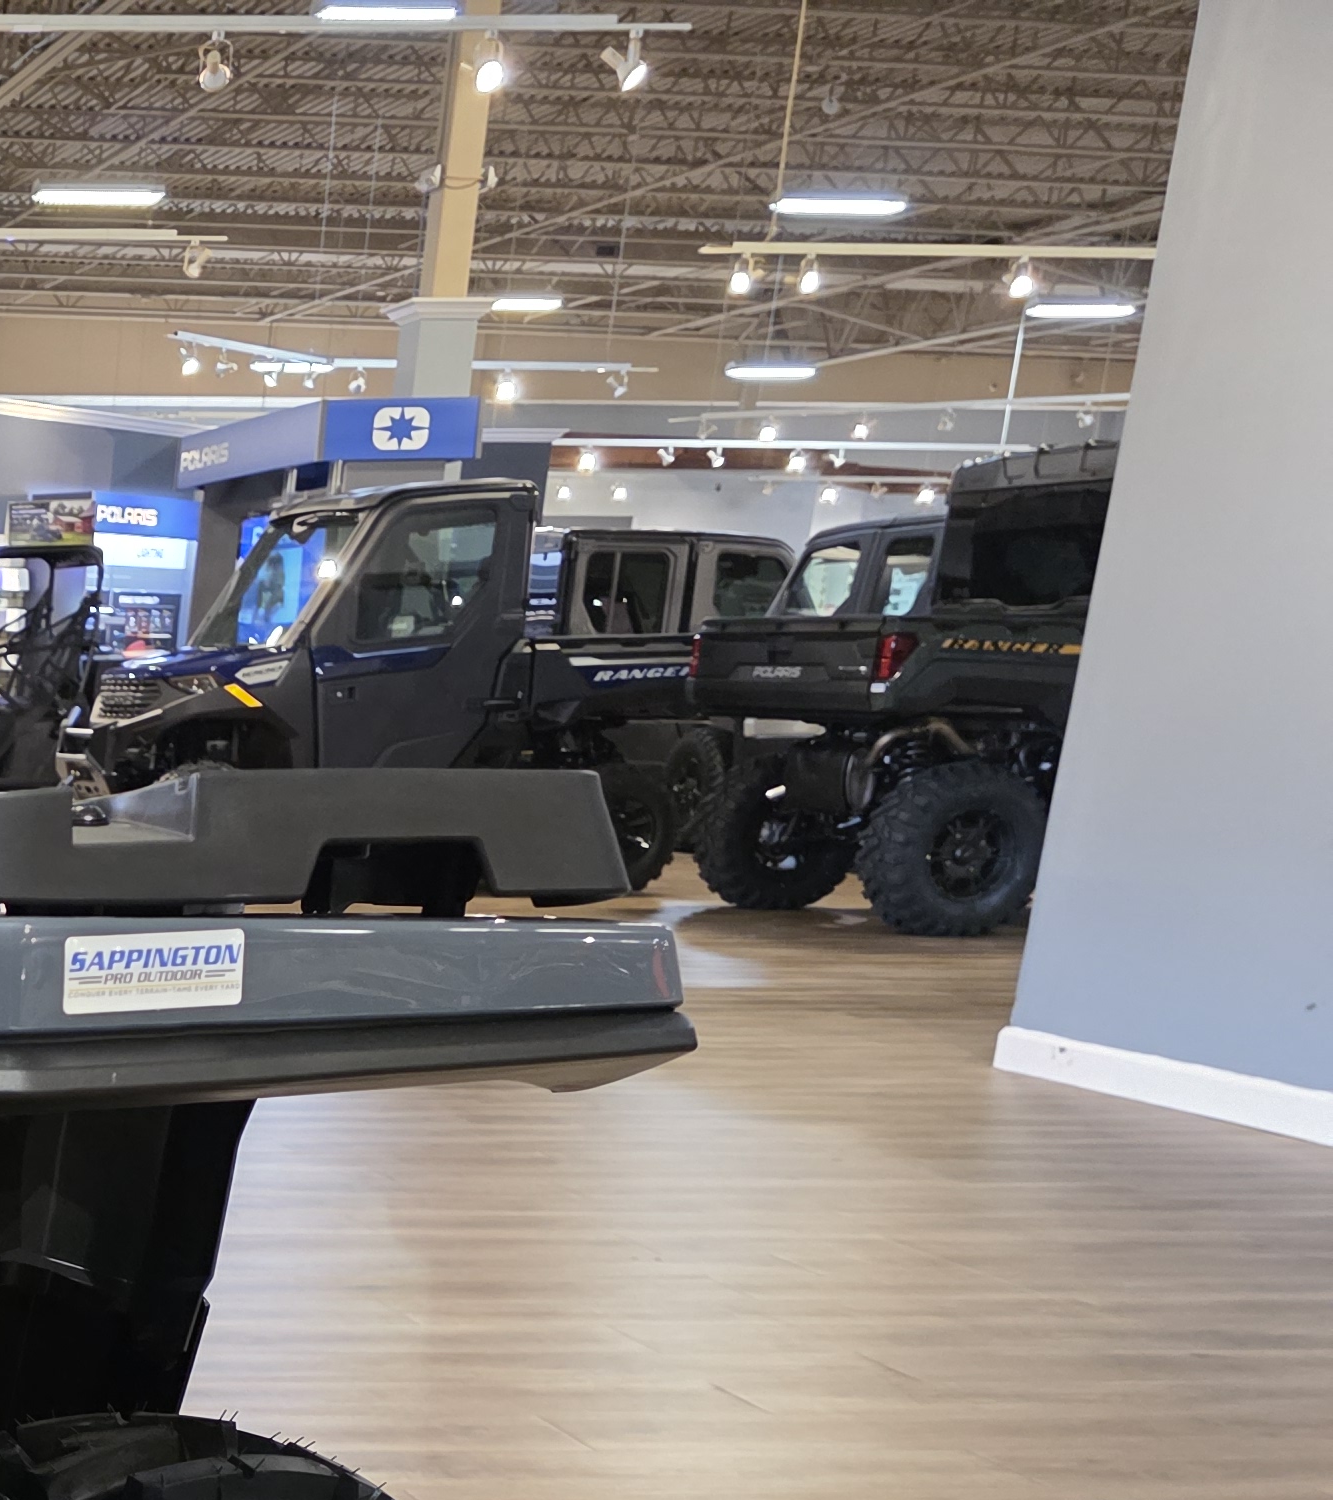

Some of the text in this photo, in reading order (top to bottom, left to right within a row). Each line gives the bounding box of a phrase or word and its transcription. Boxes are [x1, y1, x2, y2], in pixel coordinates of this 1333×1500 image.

[180, 443, 229, 472] POLARIS
[96, 505, 159, 527] POLARIS
[752, 665, 803, 679] POLARIS
[69, 943, 242, 973] SAPPINGTON
[103, 968, 203, 985] PRO OUTDOOR
[68, 990, 106, 999] CONQUER
[109, 989, 133, 997] EVERY
